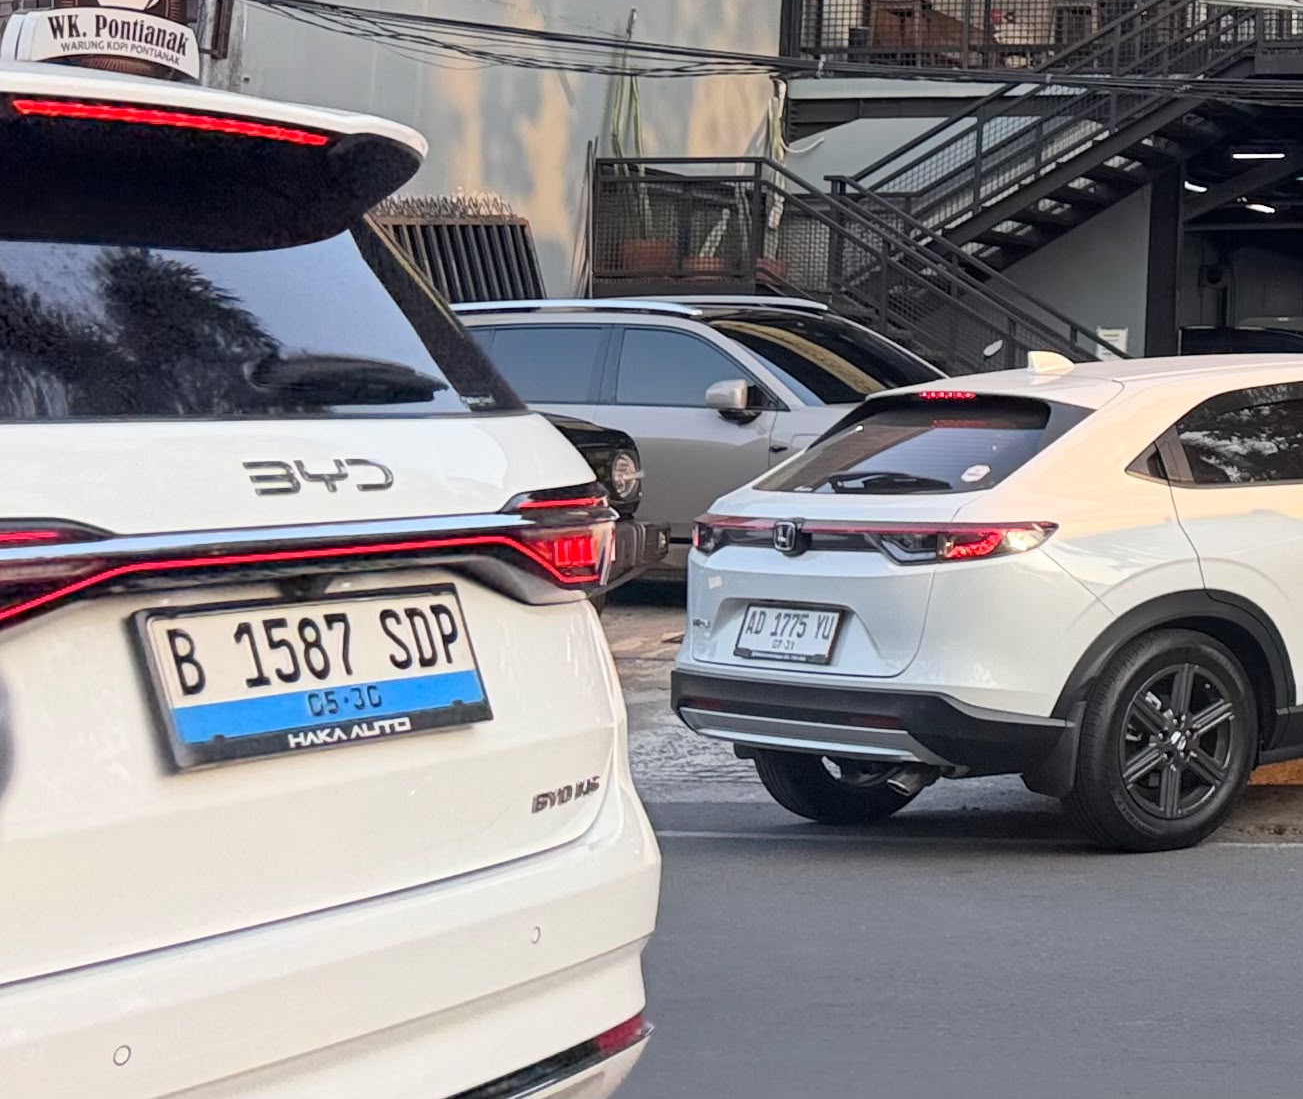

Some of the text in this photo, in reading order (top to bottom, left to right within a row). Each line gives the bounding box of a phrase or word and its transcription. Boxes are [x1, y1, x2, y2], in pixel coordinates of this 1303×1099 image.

[48, 14, 189, 57] WK. Pontianak
[60, 40, 181, 67] WARUNG KOPI PONTIANAK
[242, 458, 394, 496] BYD
[744, 610, 836, 640] AD 1775 YU
[166, 603, 459, 696] B 1587 SDP
[287, 716, 412, 749] HAKA AUTO
